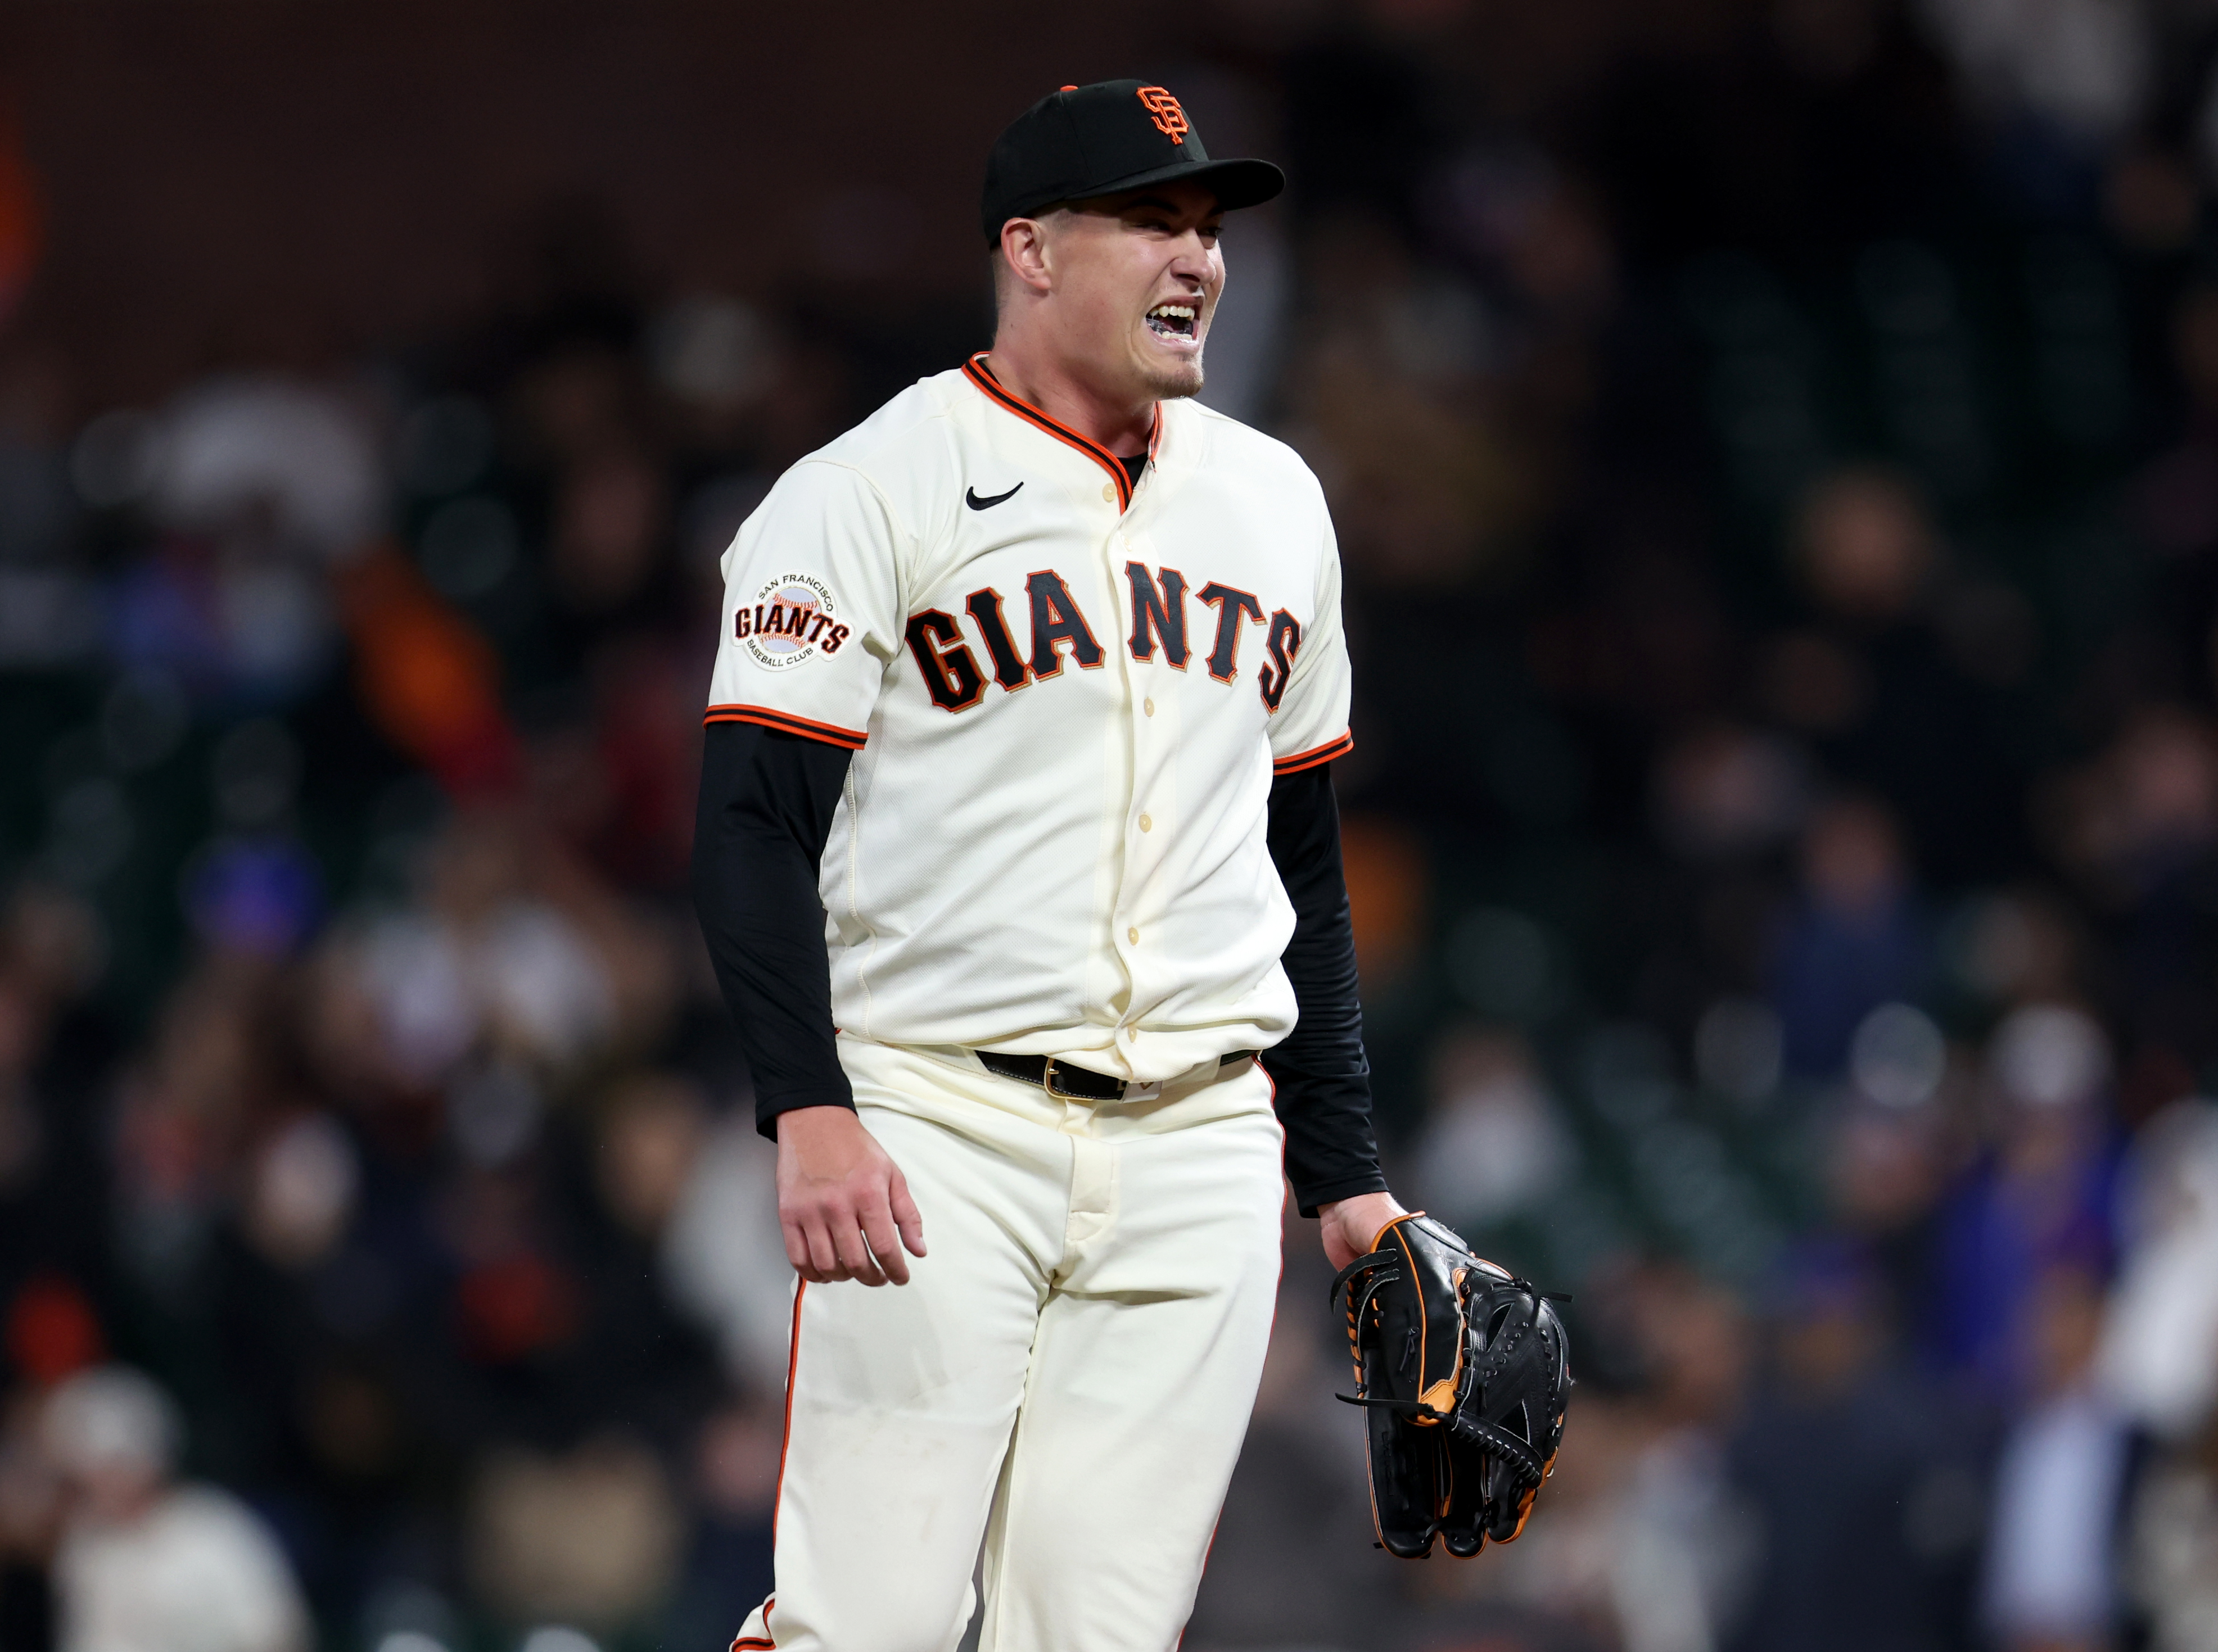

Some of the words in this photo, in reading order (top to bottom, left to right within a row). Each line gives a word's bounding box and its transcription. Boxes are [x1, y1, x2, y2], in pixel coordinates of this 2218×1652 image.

[758, 579, 779, 600] SAN
[783, 574, 834, 612] FRANCISCO
[734, 604, 850, 654] GIANTS
[906, 560, 1301, 714] GIANTS
[747, 639, 784, 667] BASEBALL
[787, 648, 814, 664] CLUB
